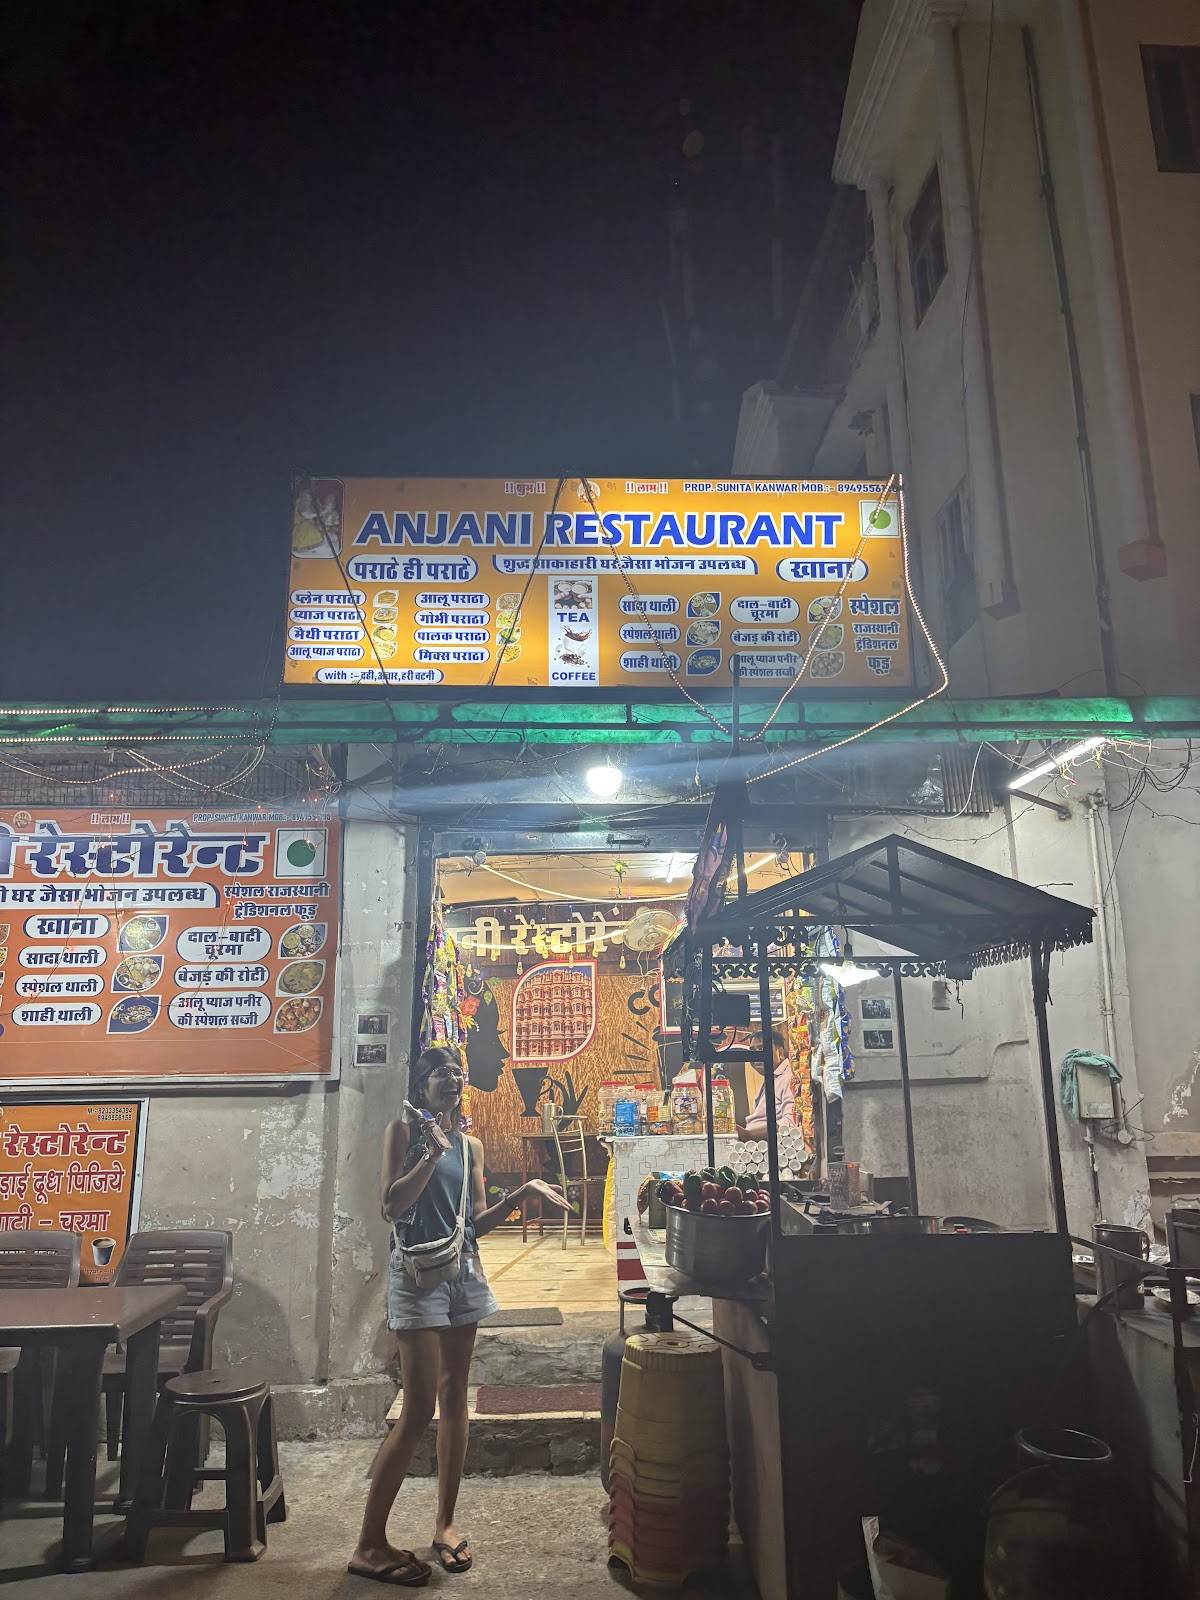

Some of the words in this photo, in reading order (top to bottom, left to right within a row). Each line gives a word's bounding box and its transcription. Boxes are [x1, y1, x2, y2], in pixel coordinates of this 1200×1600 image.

[637, 483, 658, 493] लाभ
[684, 483, 714, 492] PROP.
[716, 483, 751, 492] SUNITA
[755, 483, 798, 492] KANWAR
[355, 512, 532, 546] ANJANI
[545, 513, 843, 546] RESTAURANT
[354, 557, 400, 580] पराठे
[402, 557, 424, 580] ही
[426, 557, 470, 580] पराठे
[503, 558, 531, 573] शुद्ध
[600, 558, 618, 571] घर
[621, 556, 652, 571] जैसा
[655, 556, 696, 571] भोजन
[699, 558, 747, 571] उपलब्ध
[789, 561, 855, 579] खाना
[295, 591, 324, 604] प्लेन
[326, 594, 361, 604] पराठा
[420, 594, 450, 607] आलू
[451, 594, 485, 604] पराठा
[622, 599, 647, 612] सादा
[649, 597, 677, 612] थाली
[849, 594, 900, 615] स्पेशल
[294, 610, 325, 620] प्याज
[327, 610, 362, 620] पराठा
[420, 611, 449, 624] गोभी
[451, 614, 485, 625] पराठा
[556, 612, 590, 623] TEA
[750, 609, 779, 622] चूरमा
[323, 630, 360, 640] पराठा
[853, 621, 899, 634] राजस्थानी
[417, 631, 453, 641] पालक
[455, 632, 487, 641] पराठा
[760, 630, 775, 643] की
[776, 631, 798, 643] रोटी
[289, 647, 312, 659] आलू
[312, 647, 335, 656] प्याज
[337, 647, 360, 656] पराठा
[453, 651, 485, 661] पराठा
[623, 654, 649, 669] शाही
[650, 655, 678, 669] थाली
[324, 670, 347, 680] with
[551, 671, 596, 681] COFFEE
[101, 815, 120, 824] लाभ
[26, 821, 268, 876] रेस्टोरेन्ट
[12, 888, 36, 902] घर
[39, 884, 81, 902] जैसा
[84, 884, 140, 902] भोजन
[142, 887, 207, 902] उपलब्ध
[224, 882, 265, 898] स्पेशल
[267, 882, 330, 897] राजस्थानी
[37, 917, 98, 935] खाना
[26, 952, 60, 965] सादा
[62, 949, 100, 965] थाली
[204, 944, 244, 960] चूरमा
[215, 966, 235, 982] की
[237, 965, 266, 982] रोटी
[21, 978, 63, 993] स्पेशल
[65, 978, 98, 993] थाली
[178, 996, 206, 1012] आलू
[206, 996, 234, 1008] प्याज
[235, 993, 263, 1008] पनीर
[21, 1007, 55, 1022] शाही
[57, 1006, 94, 1022] थाली
[177, 1013, 194, 1026] की
[195, 1012, 229, 1026] स्पेशल
[230, 1011, 259, 1025] सब्जी
[4, 1123, 130, 1157] रेस्टोरेन्ट
[33, 1170, 63, 1204] दूध
[67, 1160, 125, 1193] पिजिये
